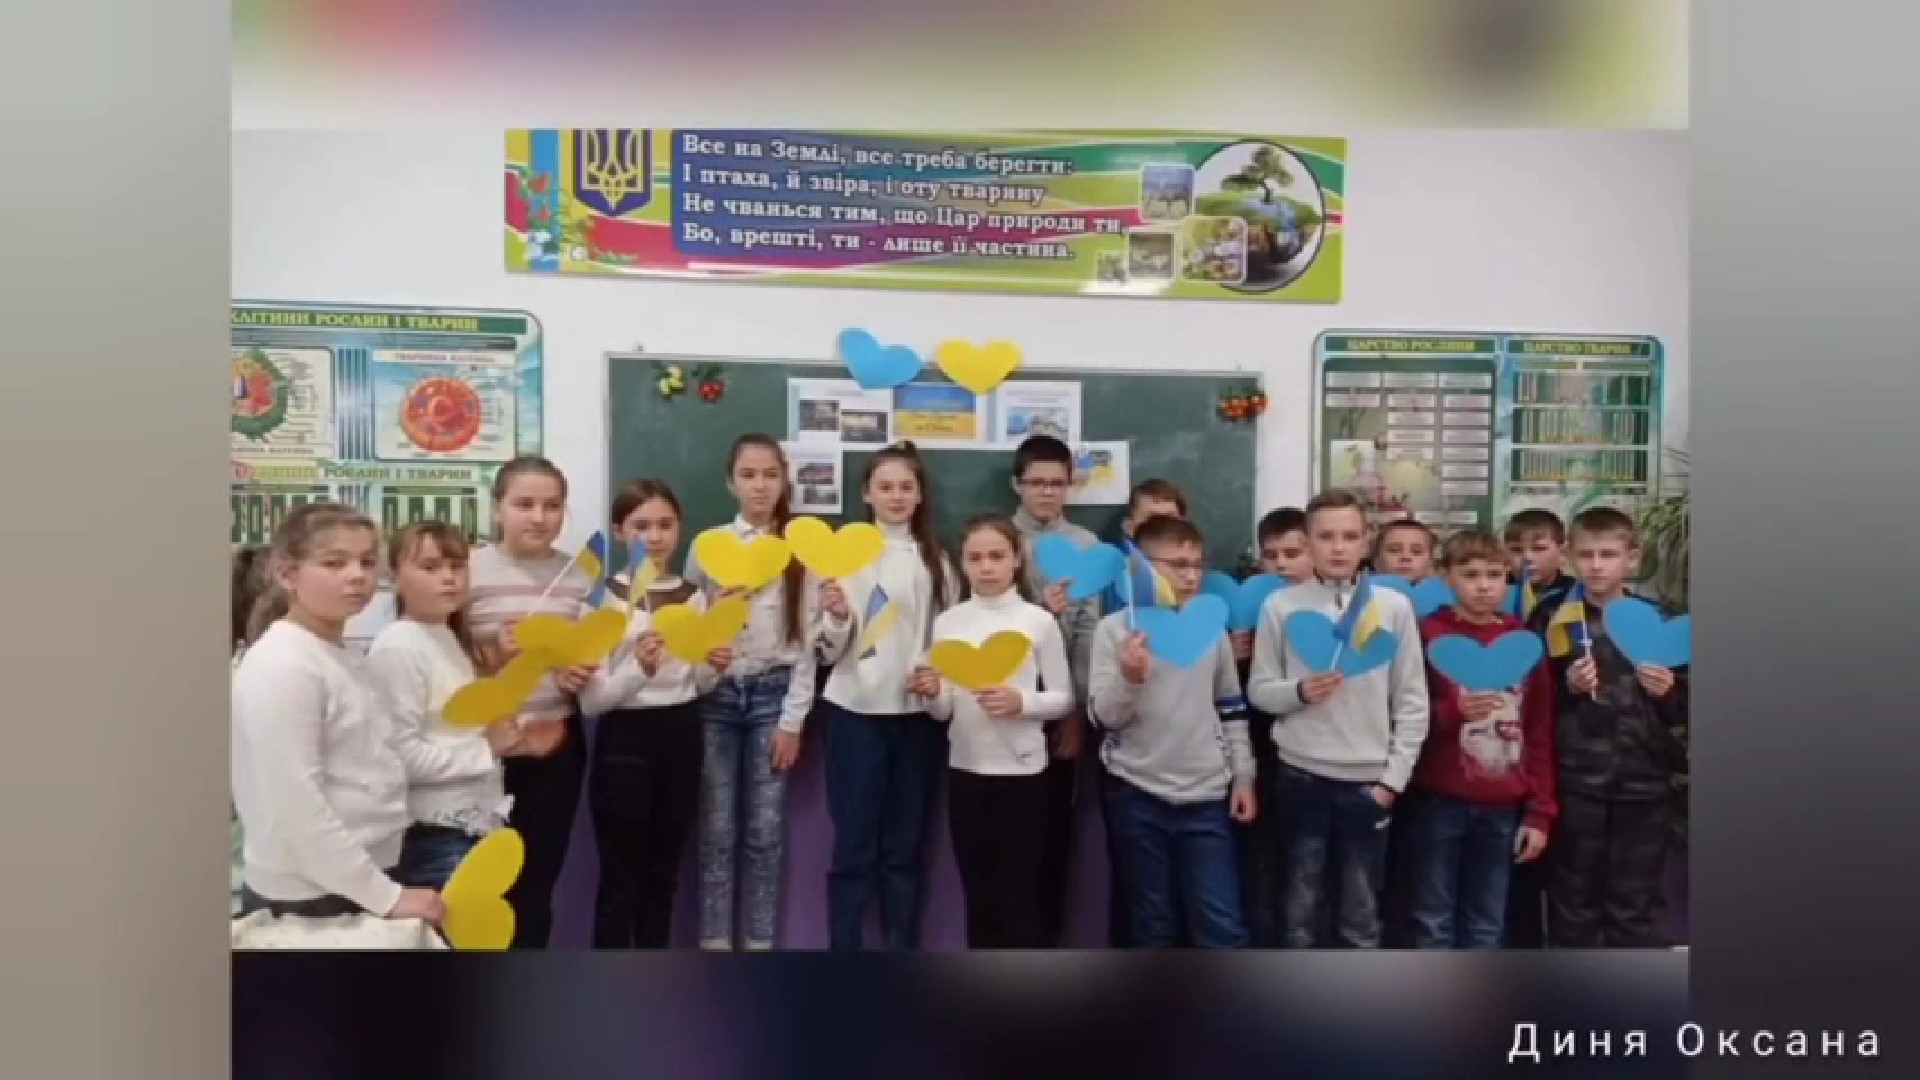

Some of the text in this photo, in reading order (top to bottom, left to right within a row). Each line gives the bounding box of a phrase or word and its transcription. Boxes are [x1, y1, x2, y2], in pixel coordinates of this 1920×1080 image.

[683, 134, 725, 155] Все
[734, 141, 763, 157] на
[771, 139, 846, 165] Землі,
[855, 149, 895, 166] все
[901, 150, 968, 172] треба
[683, 163, 1045, 207] І птаха, й звіра, і оту тварину
[683, 192, 716, 213] Не
[723, 199, 823, 219] чванься
[830, 205, 886, 225] тим,
[894, 208, 928, 226] що
[936, 206, 980, 233] Цар
[987, 213, 1086, 235] природи
[683, 222, 721, 246] Бо,
[730, 228, 824, 251] врешті,
[831, 233, 861, 249] ти
[883, 236, 945, 254] лише
[952, 234, 969, 254] її
[973, 240, 1076, 259] частина.
[316, 313, 389, 328] РОСЛИН
[408, 315, 479, 331] ТВАРИН
